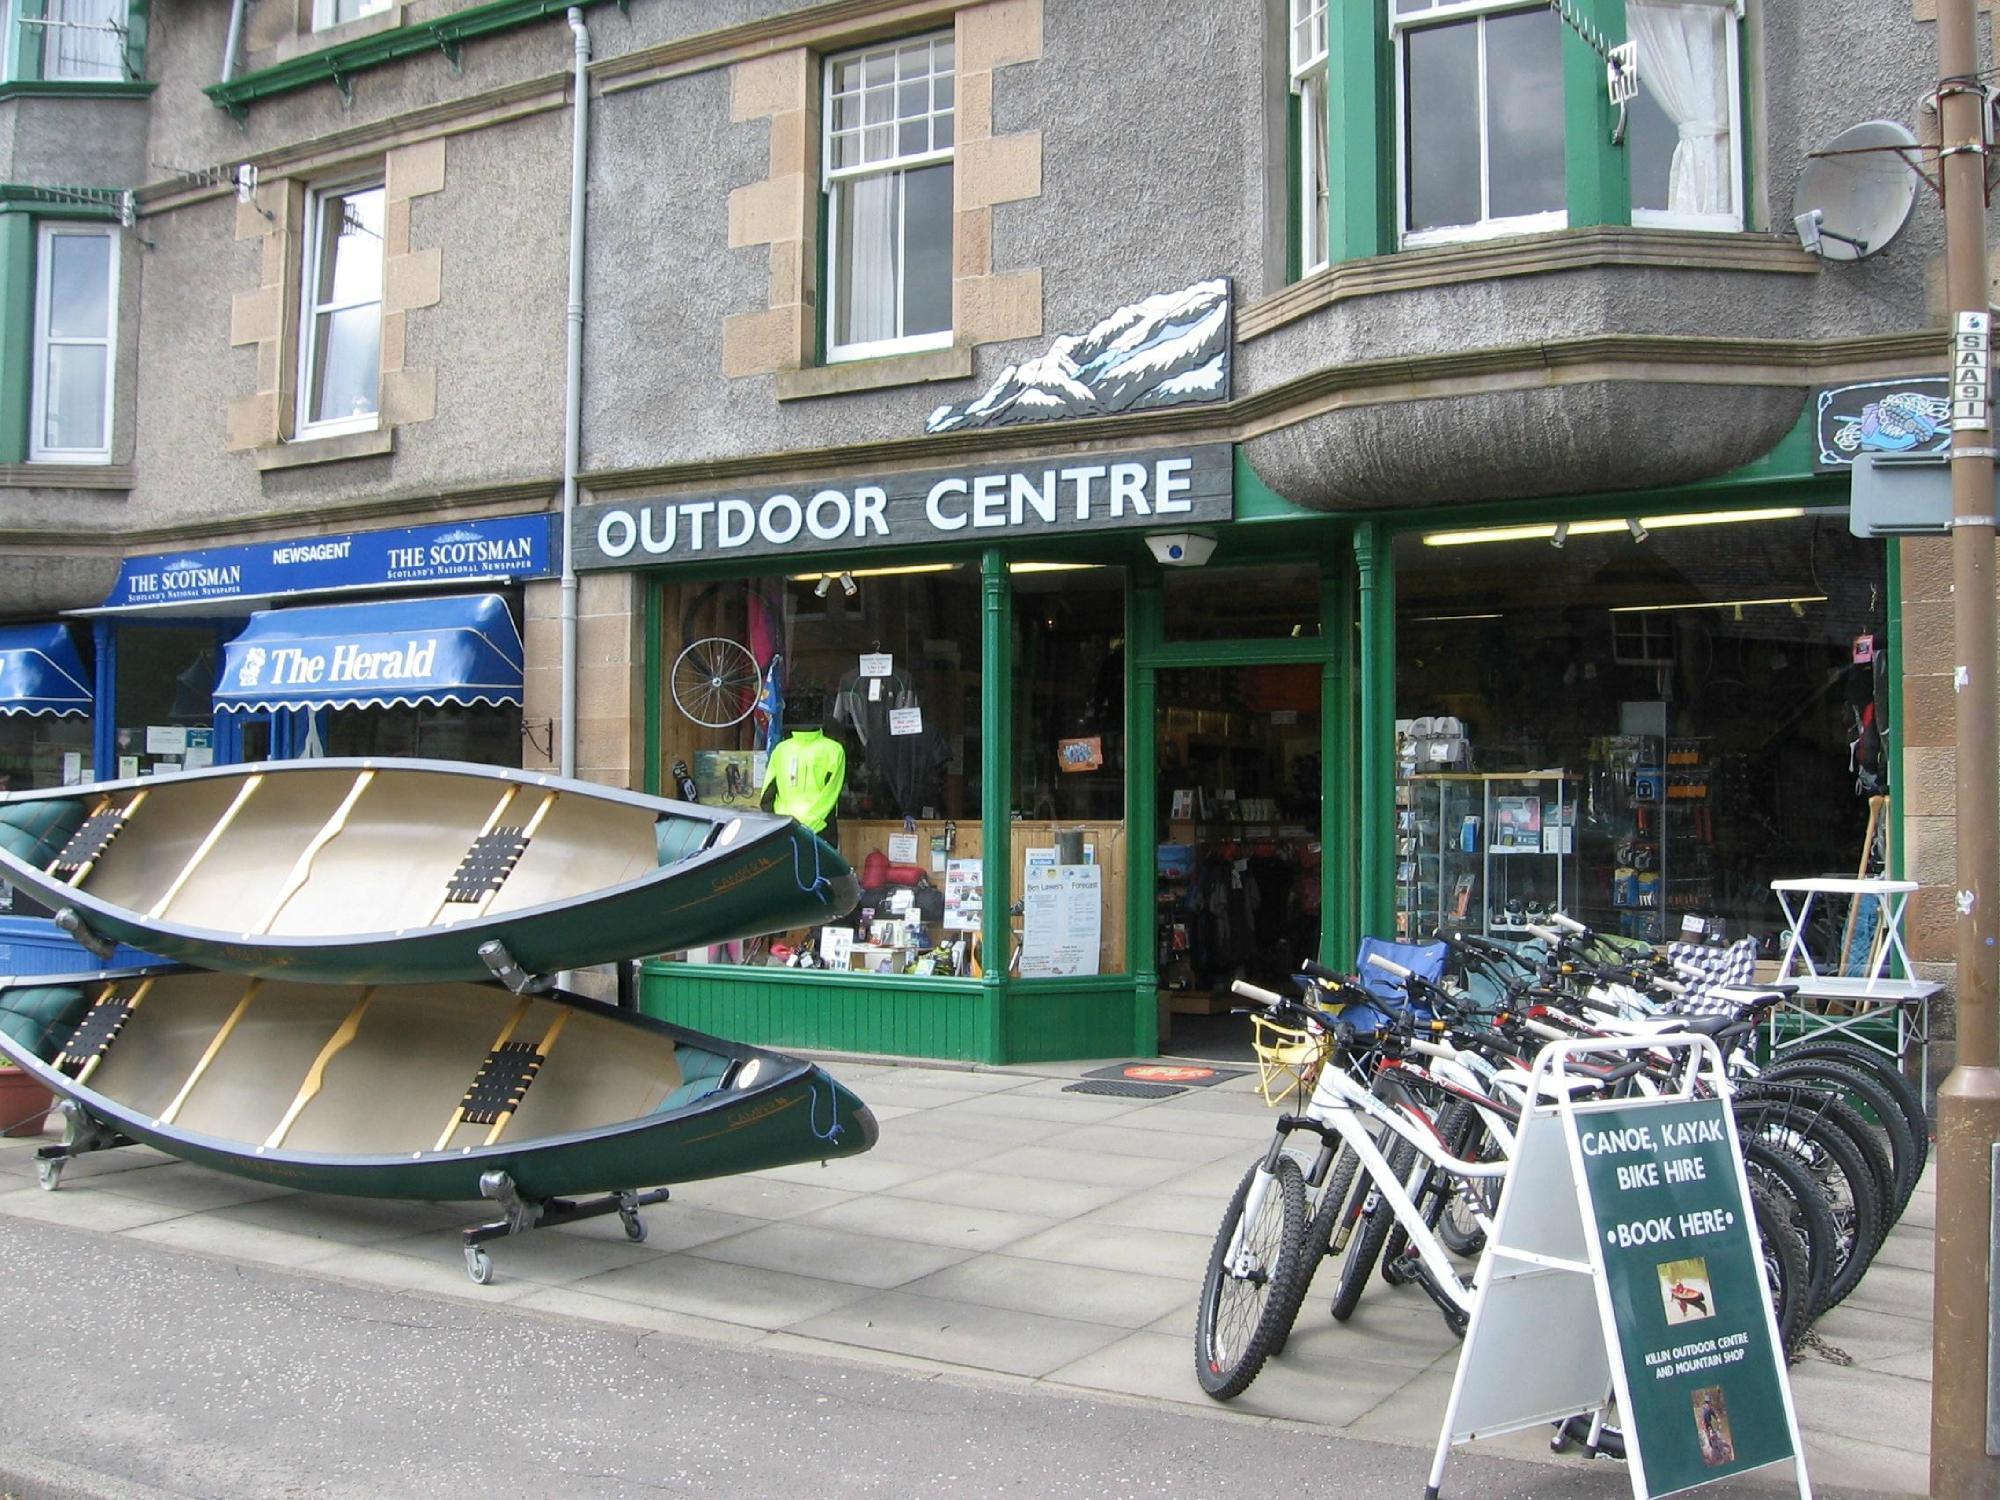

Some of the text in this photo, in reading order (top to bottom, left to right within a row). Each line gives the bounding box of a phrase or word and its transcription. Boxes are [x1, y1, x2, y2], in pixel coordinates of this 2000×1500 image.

[598, 457, 1193, 558] OUTDOOR CENTRE
[273, 541, 351, 565] NEWSAGENT
[387, 537, 531, 569] THE SCOTSMAN
[128, 565, 240, 593] THE SCOTSMAN
[387, 560, 532, 579] SCOTLAND'S NATIONAL NEWSPAPER
[270, 639, 437, 685] The Herald
[1072, 881, 1098, 890] Forecast
[1582, 1118, 1724, 1156] CANOE, KAYAK
[1616, 1157, 1706, 1190] BIKE HIRE
[1645, 1332, 1749, 1365] KILLIN OUTDOOR CENTRE
[1656, 1348, 1745, 1379] AND MOUNTAIN SHOP
